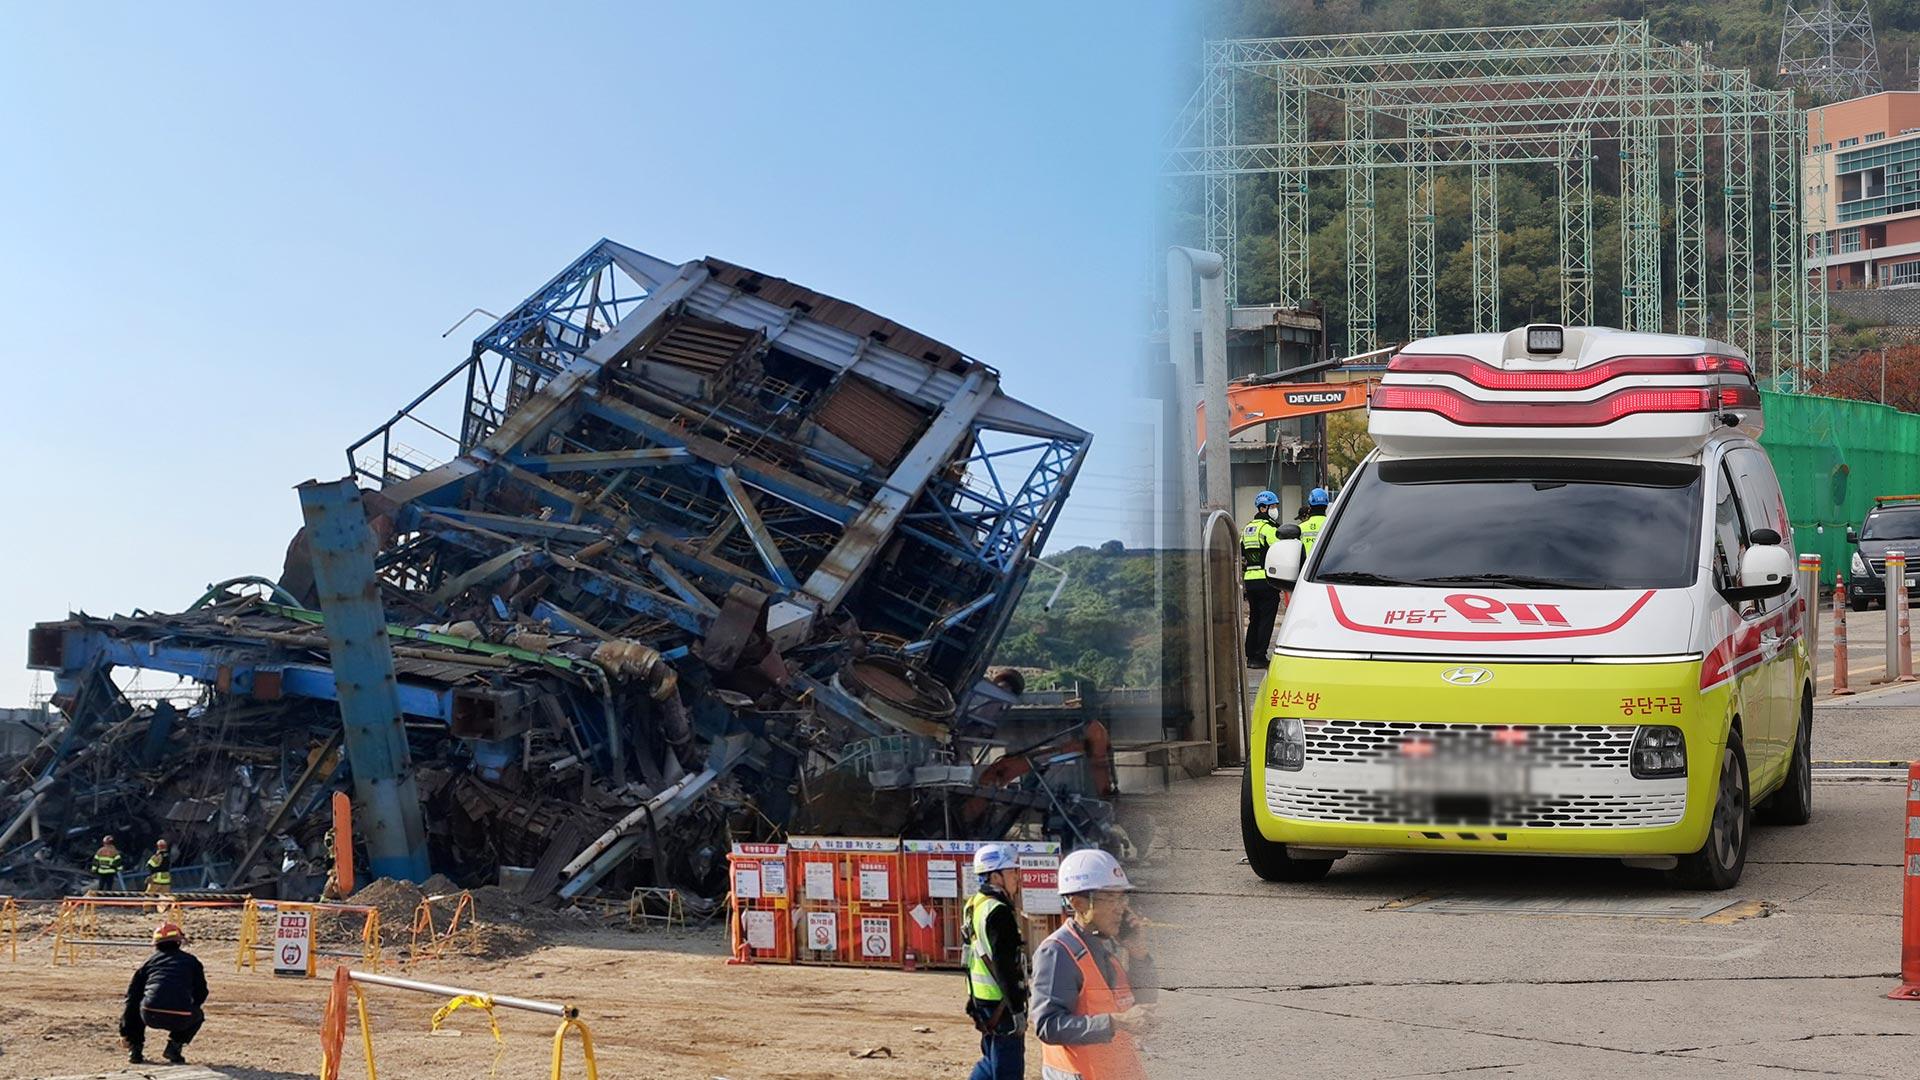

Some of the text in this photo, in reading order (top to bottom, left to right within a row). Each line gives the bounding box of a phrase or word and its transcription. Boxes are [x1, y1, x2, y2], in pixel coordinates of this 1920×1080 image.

[1289, 393, 1342, 403] DEVELON
[1271, 688, 1321, 711] 울산소방
[1619, 697, 1683, 716] 공단구급
[277, 928, 308, 938] 출입금지
